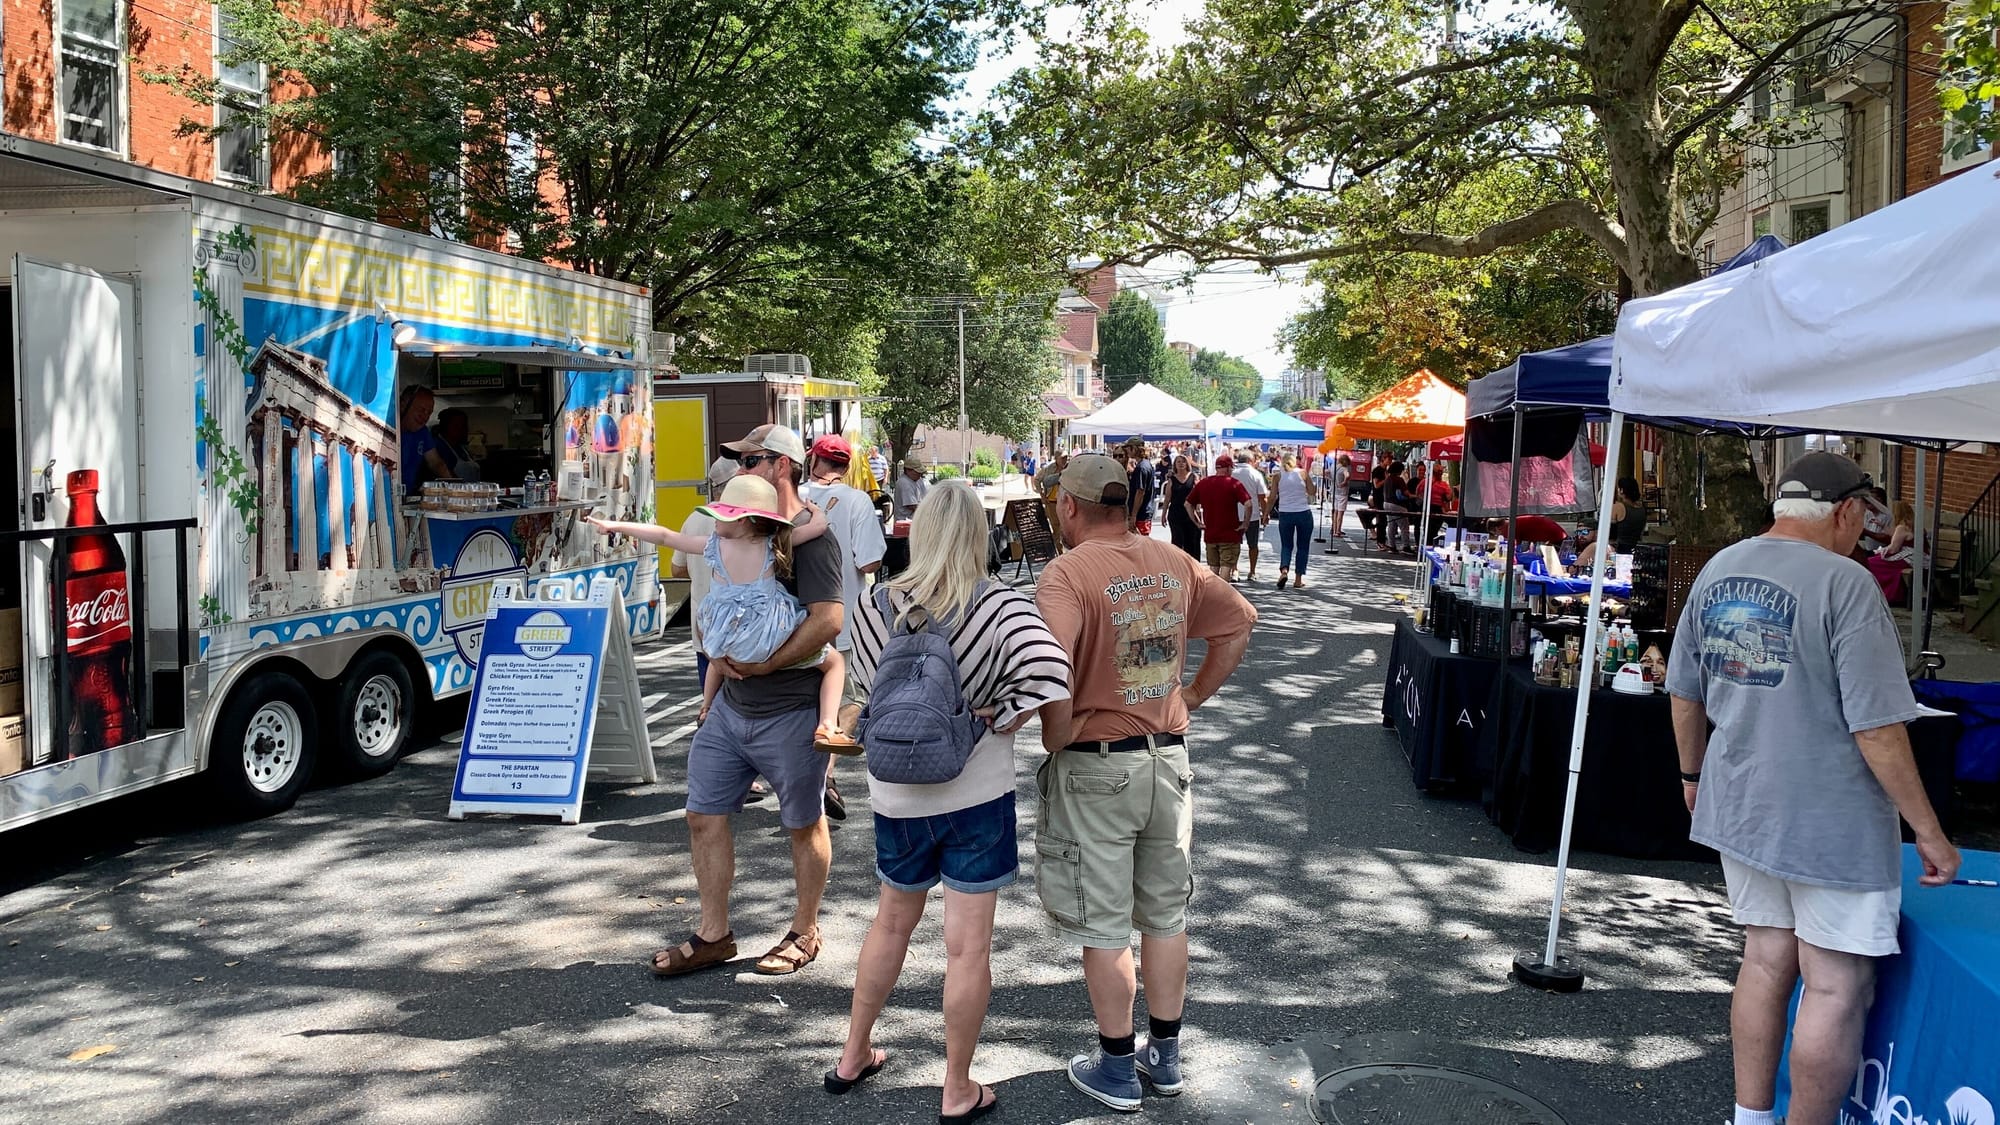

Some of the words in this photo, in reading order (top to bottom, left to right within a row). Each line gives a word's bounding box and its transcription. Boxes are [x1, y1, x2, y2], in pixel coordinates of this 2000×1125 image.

[1159, 573, 1183, 590] Bar
[1701, 581, 1798, 619] CATAMARAN
[521, 630, 565, 641] GREEK
[512, 673, 533, 681] Fingers
[1123, 687, 1138, 706] No
[478, 732, 498, 740] Veggie
[498, 732, 512, 740] Gyro
[511, 782, 522, 790] 13
